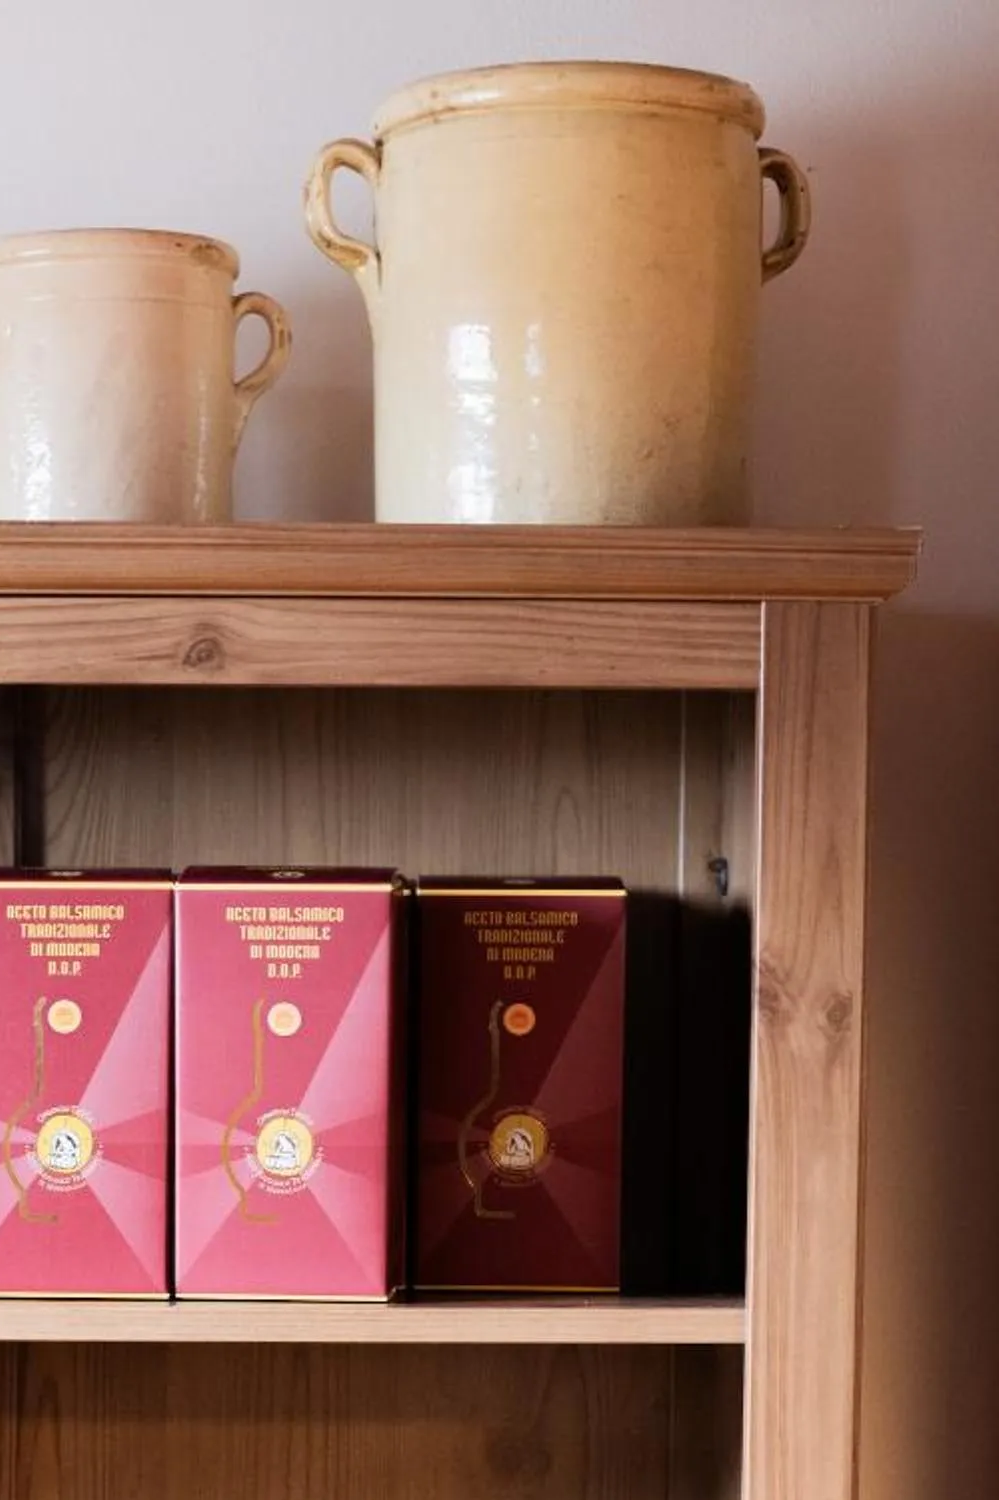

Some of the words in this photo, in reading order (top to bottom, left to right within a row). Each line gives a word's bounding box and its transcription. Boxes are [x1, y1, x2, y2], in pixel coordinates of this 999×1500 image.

[6, 905, 47, 919] ACETO
[49, 905, 124, 920] BALSAMICO
[226, 907, 267, 921] ACETO
[268, 907, 344, 922] BALSAMICO
